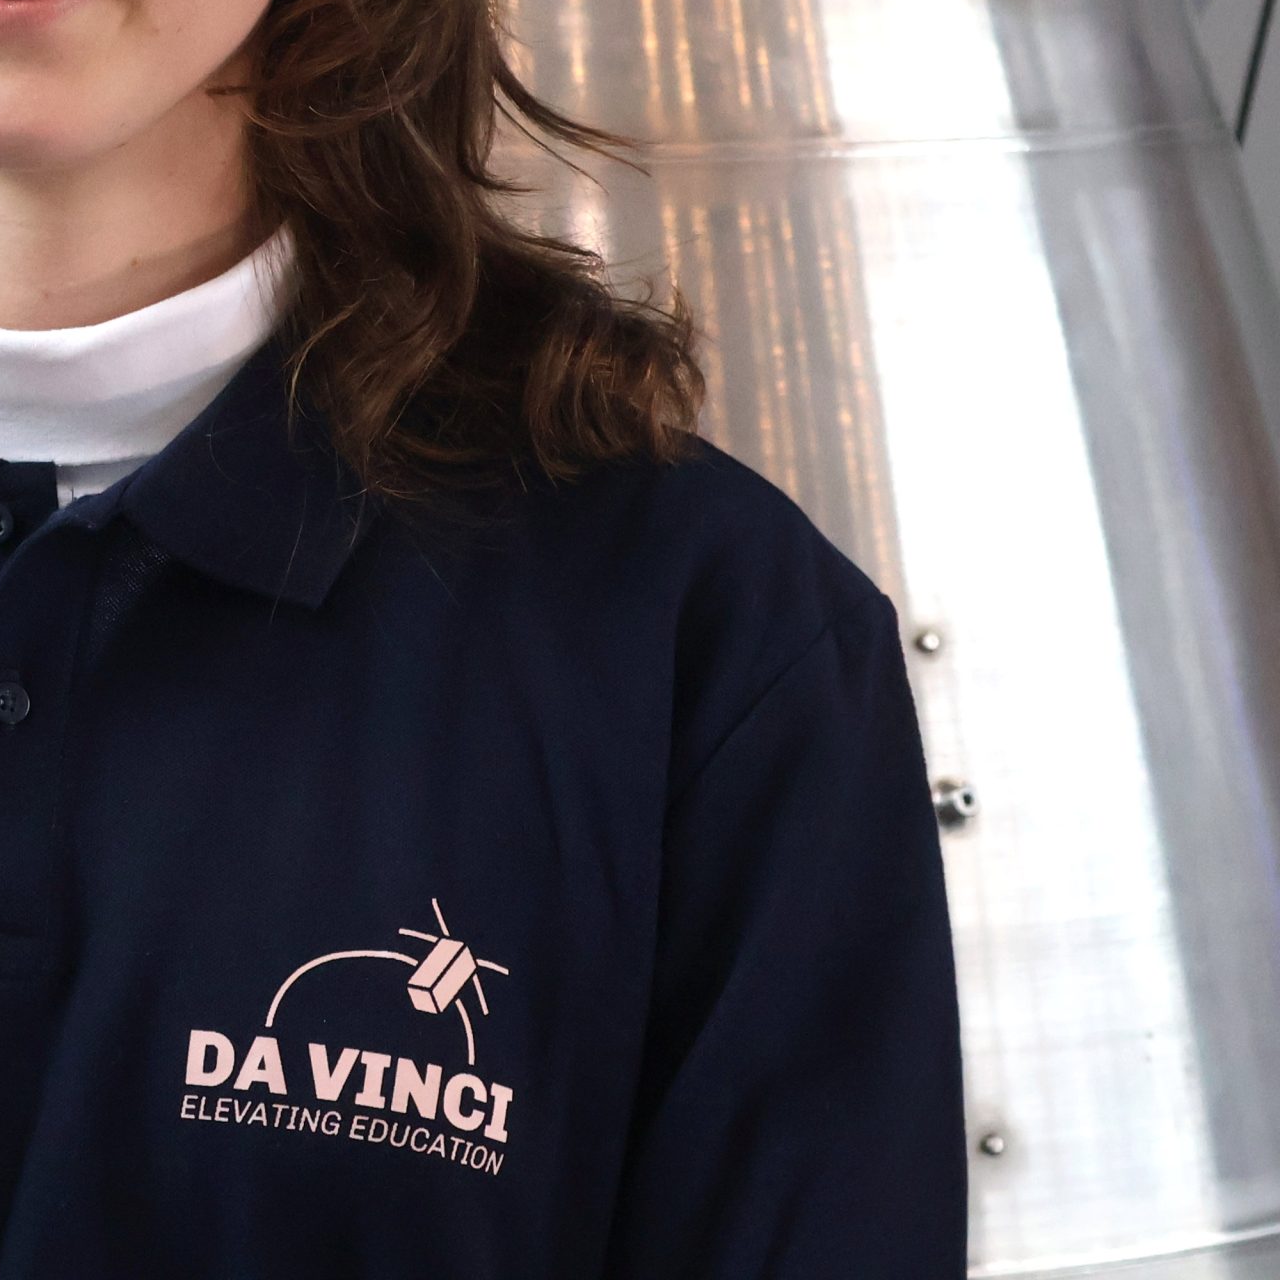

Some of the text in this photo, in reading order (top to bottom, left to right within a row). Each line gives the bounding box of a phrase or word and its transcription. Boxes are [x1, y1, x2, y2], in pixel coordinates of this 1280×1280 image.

[181, 1095, 505, 1176] ELEVATING EDUCATION
[185, 1029, 514, 1144] DA VINCI
